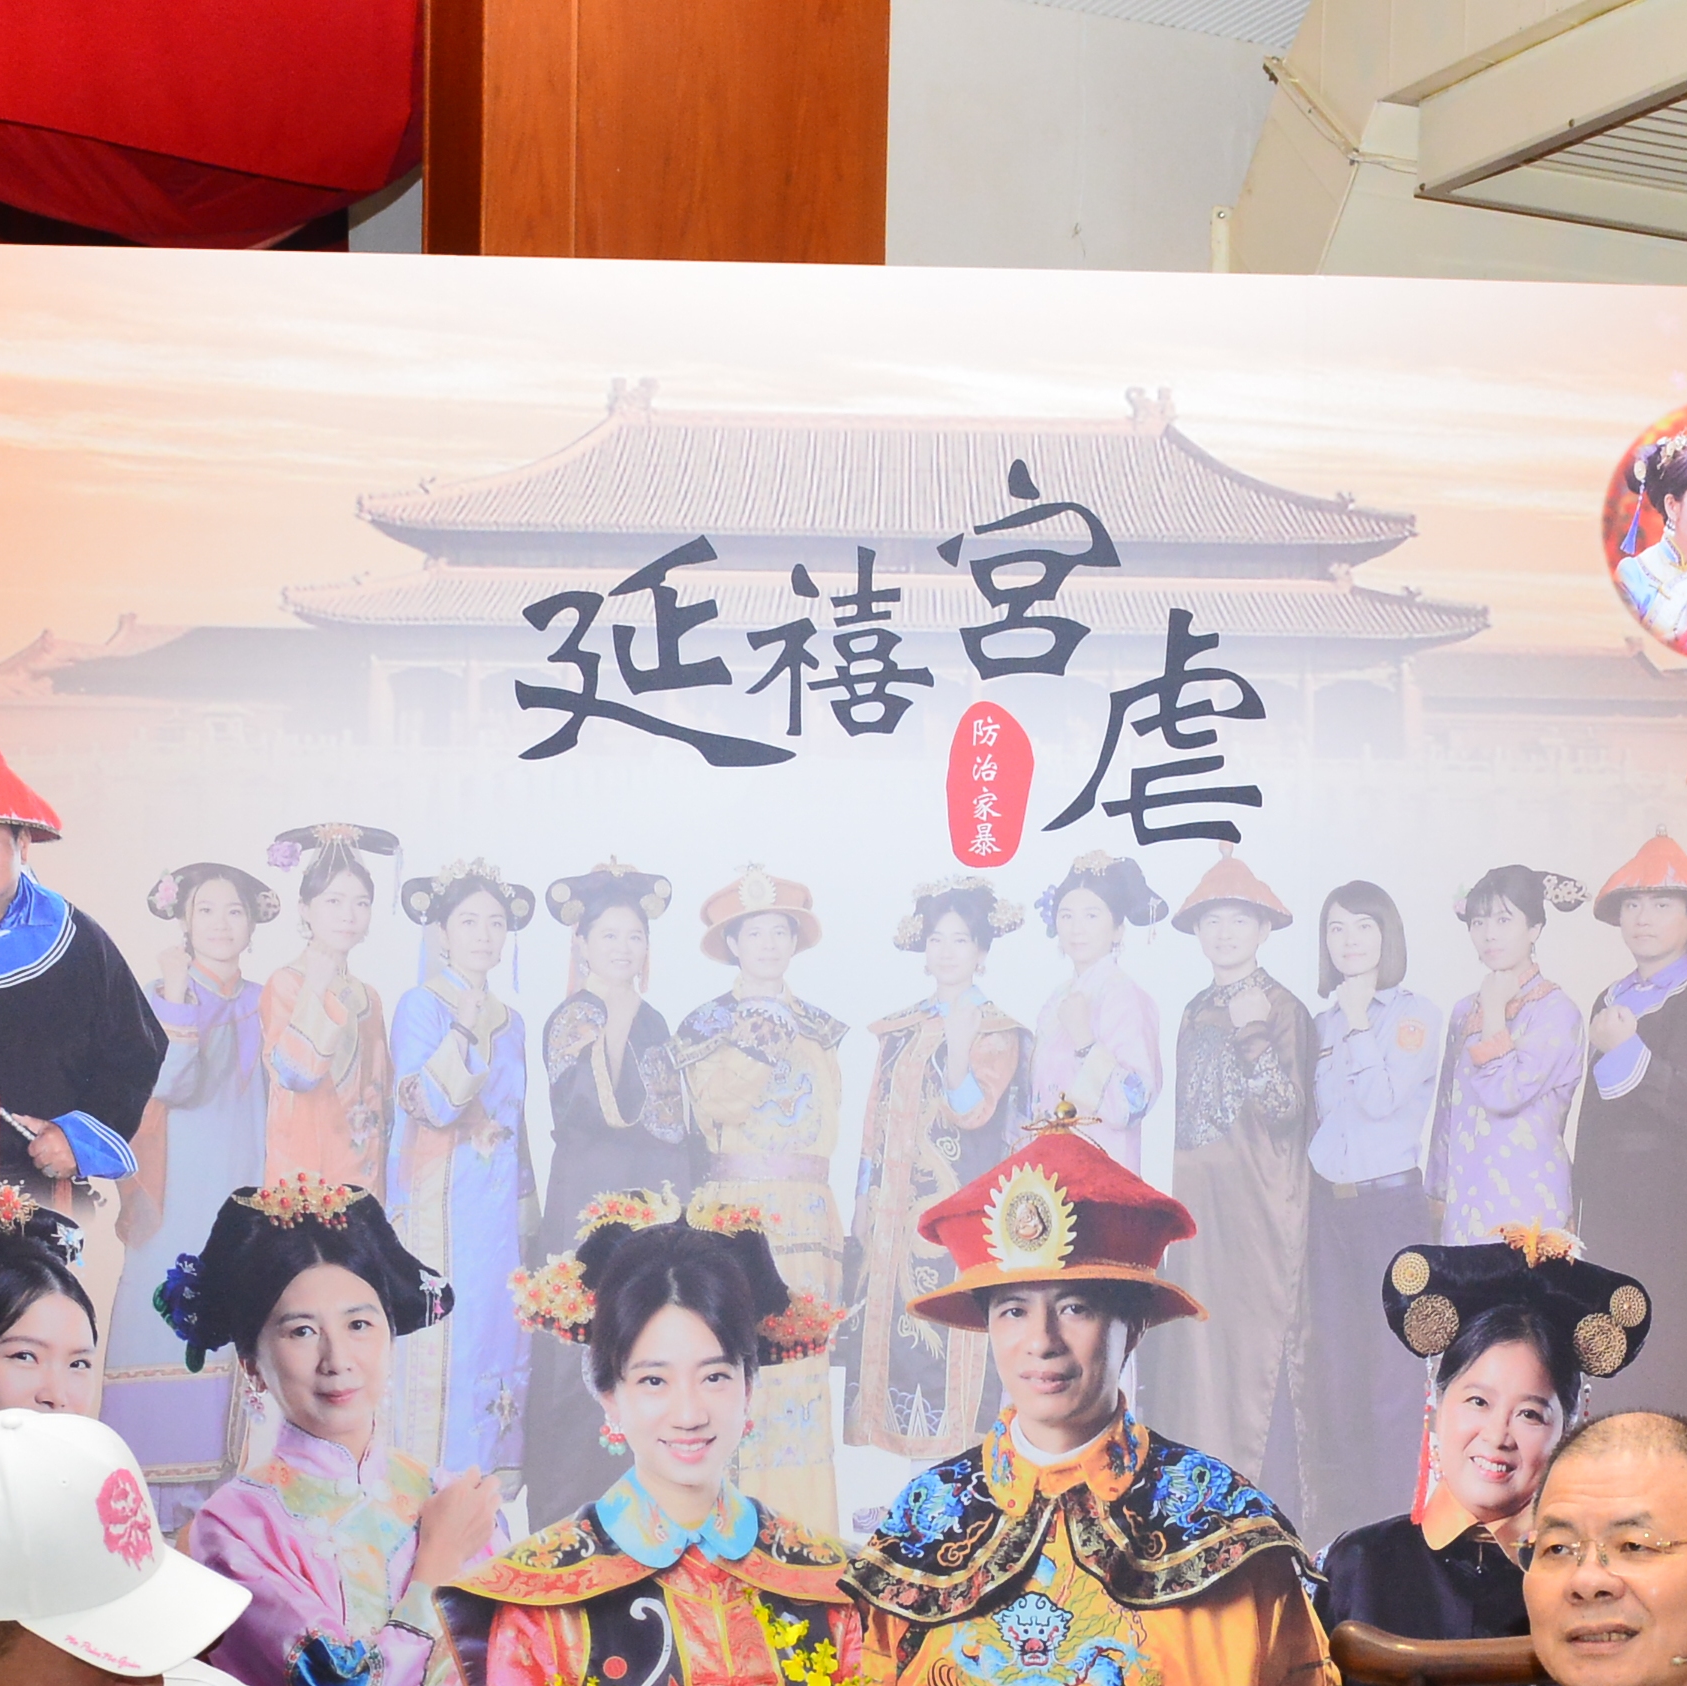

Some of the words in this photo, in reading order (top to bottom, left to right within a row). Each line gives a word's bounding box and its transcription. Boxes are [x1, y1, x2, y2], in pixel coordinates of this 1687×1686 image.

[515, 459, 1266, 845] 延禧宮虐
[968, 716, 1002, 856] 防治家暴
